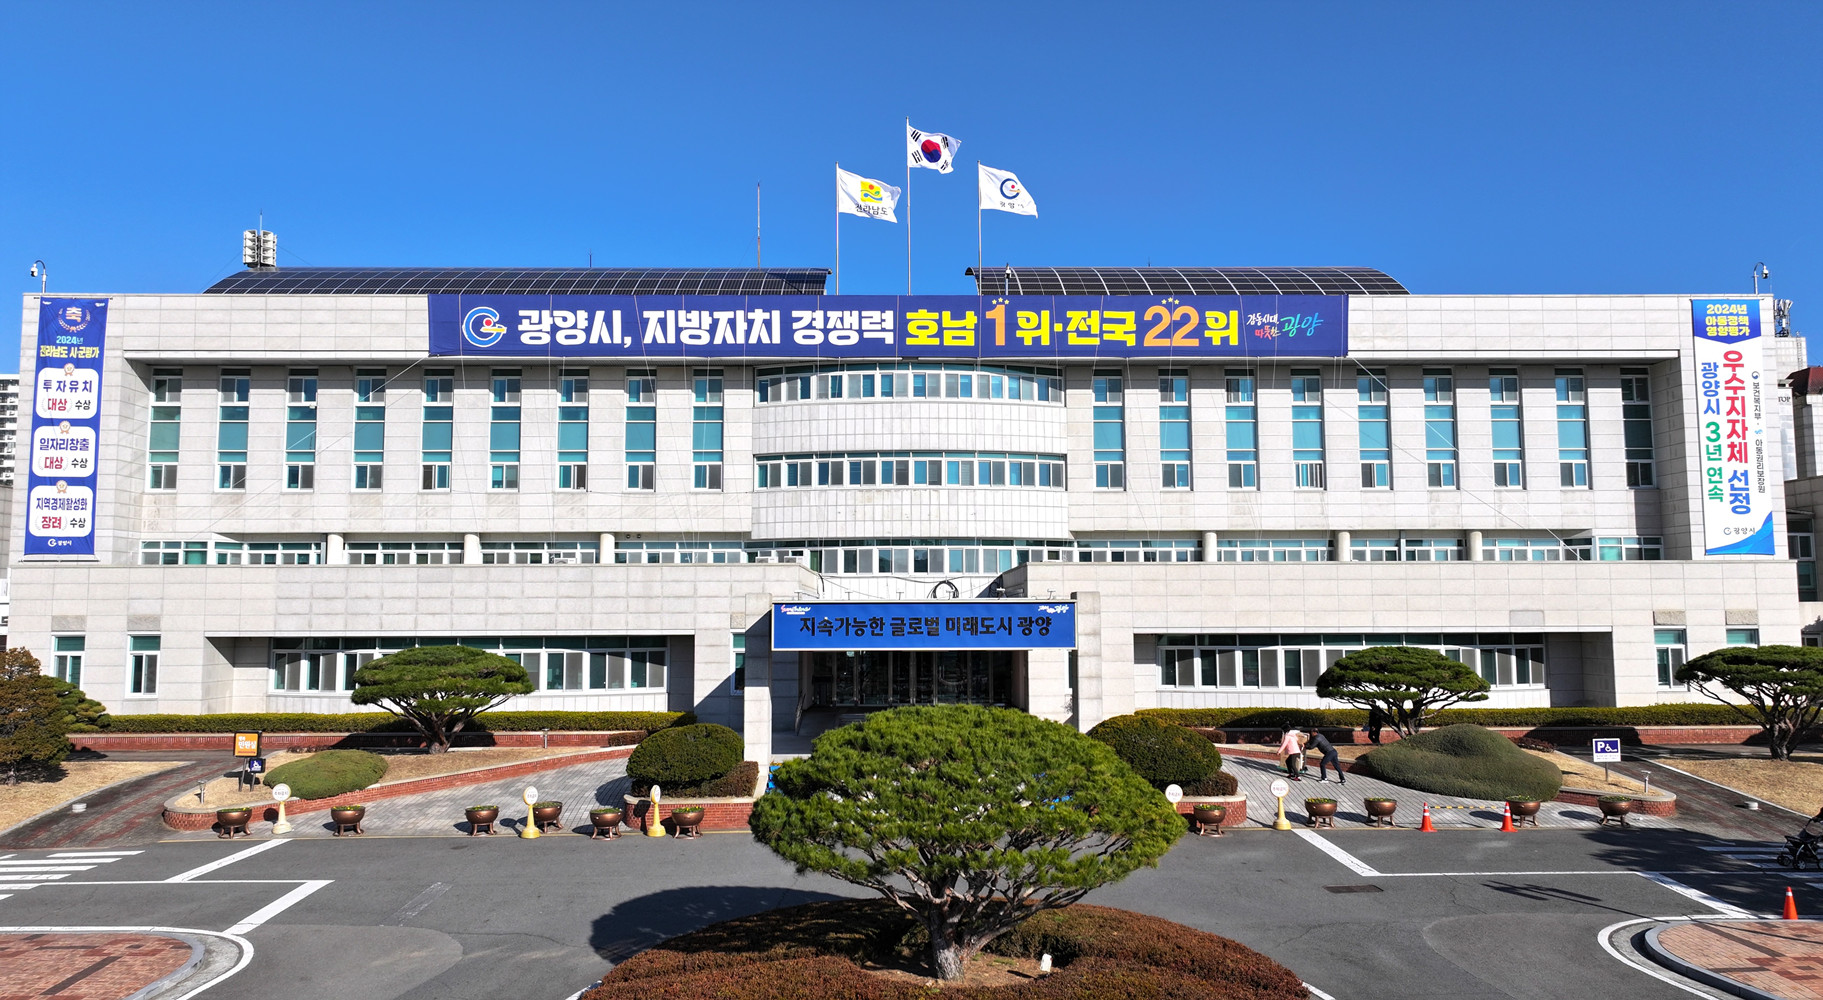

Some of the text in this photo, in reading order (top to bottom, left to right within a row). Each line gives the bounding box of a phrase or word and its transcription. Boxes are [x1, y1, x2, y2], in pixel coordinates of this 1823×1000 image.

[65, 307, 82, 323] 축
[1706, 304, 1748, 314] 2024년
[1280, 312, 1324, 338] 광양
[1705, 315, 1750, 326] 아동정책
[516, 309, 632, 349] 광양시,
[642, 309, 781, 346] 지방자치
[790, 309, 895, 346] 경쟁력
[905, 309, 978, 347] 호남
[1254, 325, 1281, 340] 따뜻한
[1706, 326, 1751, 337] 영향평가
[56, 335, 84, 345] 2024년
[40, 345, 69, 358] 전라남도
[47, 398, 91, 411] 대상 수상
[1701, 362, 1724, 503] 광양시 3년 연속
[1722, 350, 1751, 515] 우수지자체 선정
[39, 437, 90, 452] 일자리창출
[44, 456, 88, 470] 대상 수상
[36, 497, 88, 511] 지역경제활성화
[41, 516, 86, 529] 장려 수상
[1733, 527, 1756, 535] 광양시
[799, 616, 1052, 637] 지속가능한 글로벌 미래도시 광양
[1597, 741, 1605, 752] P
